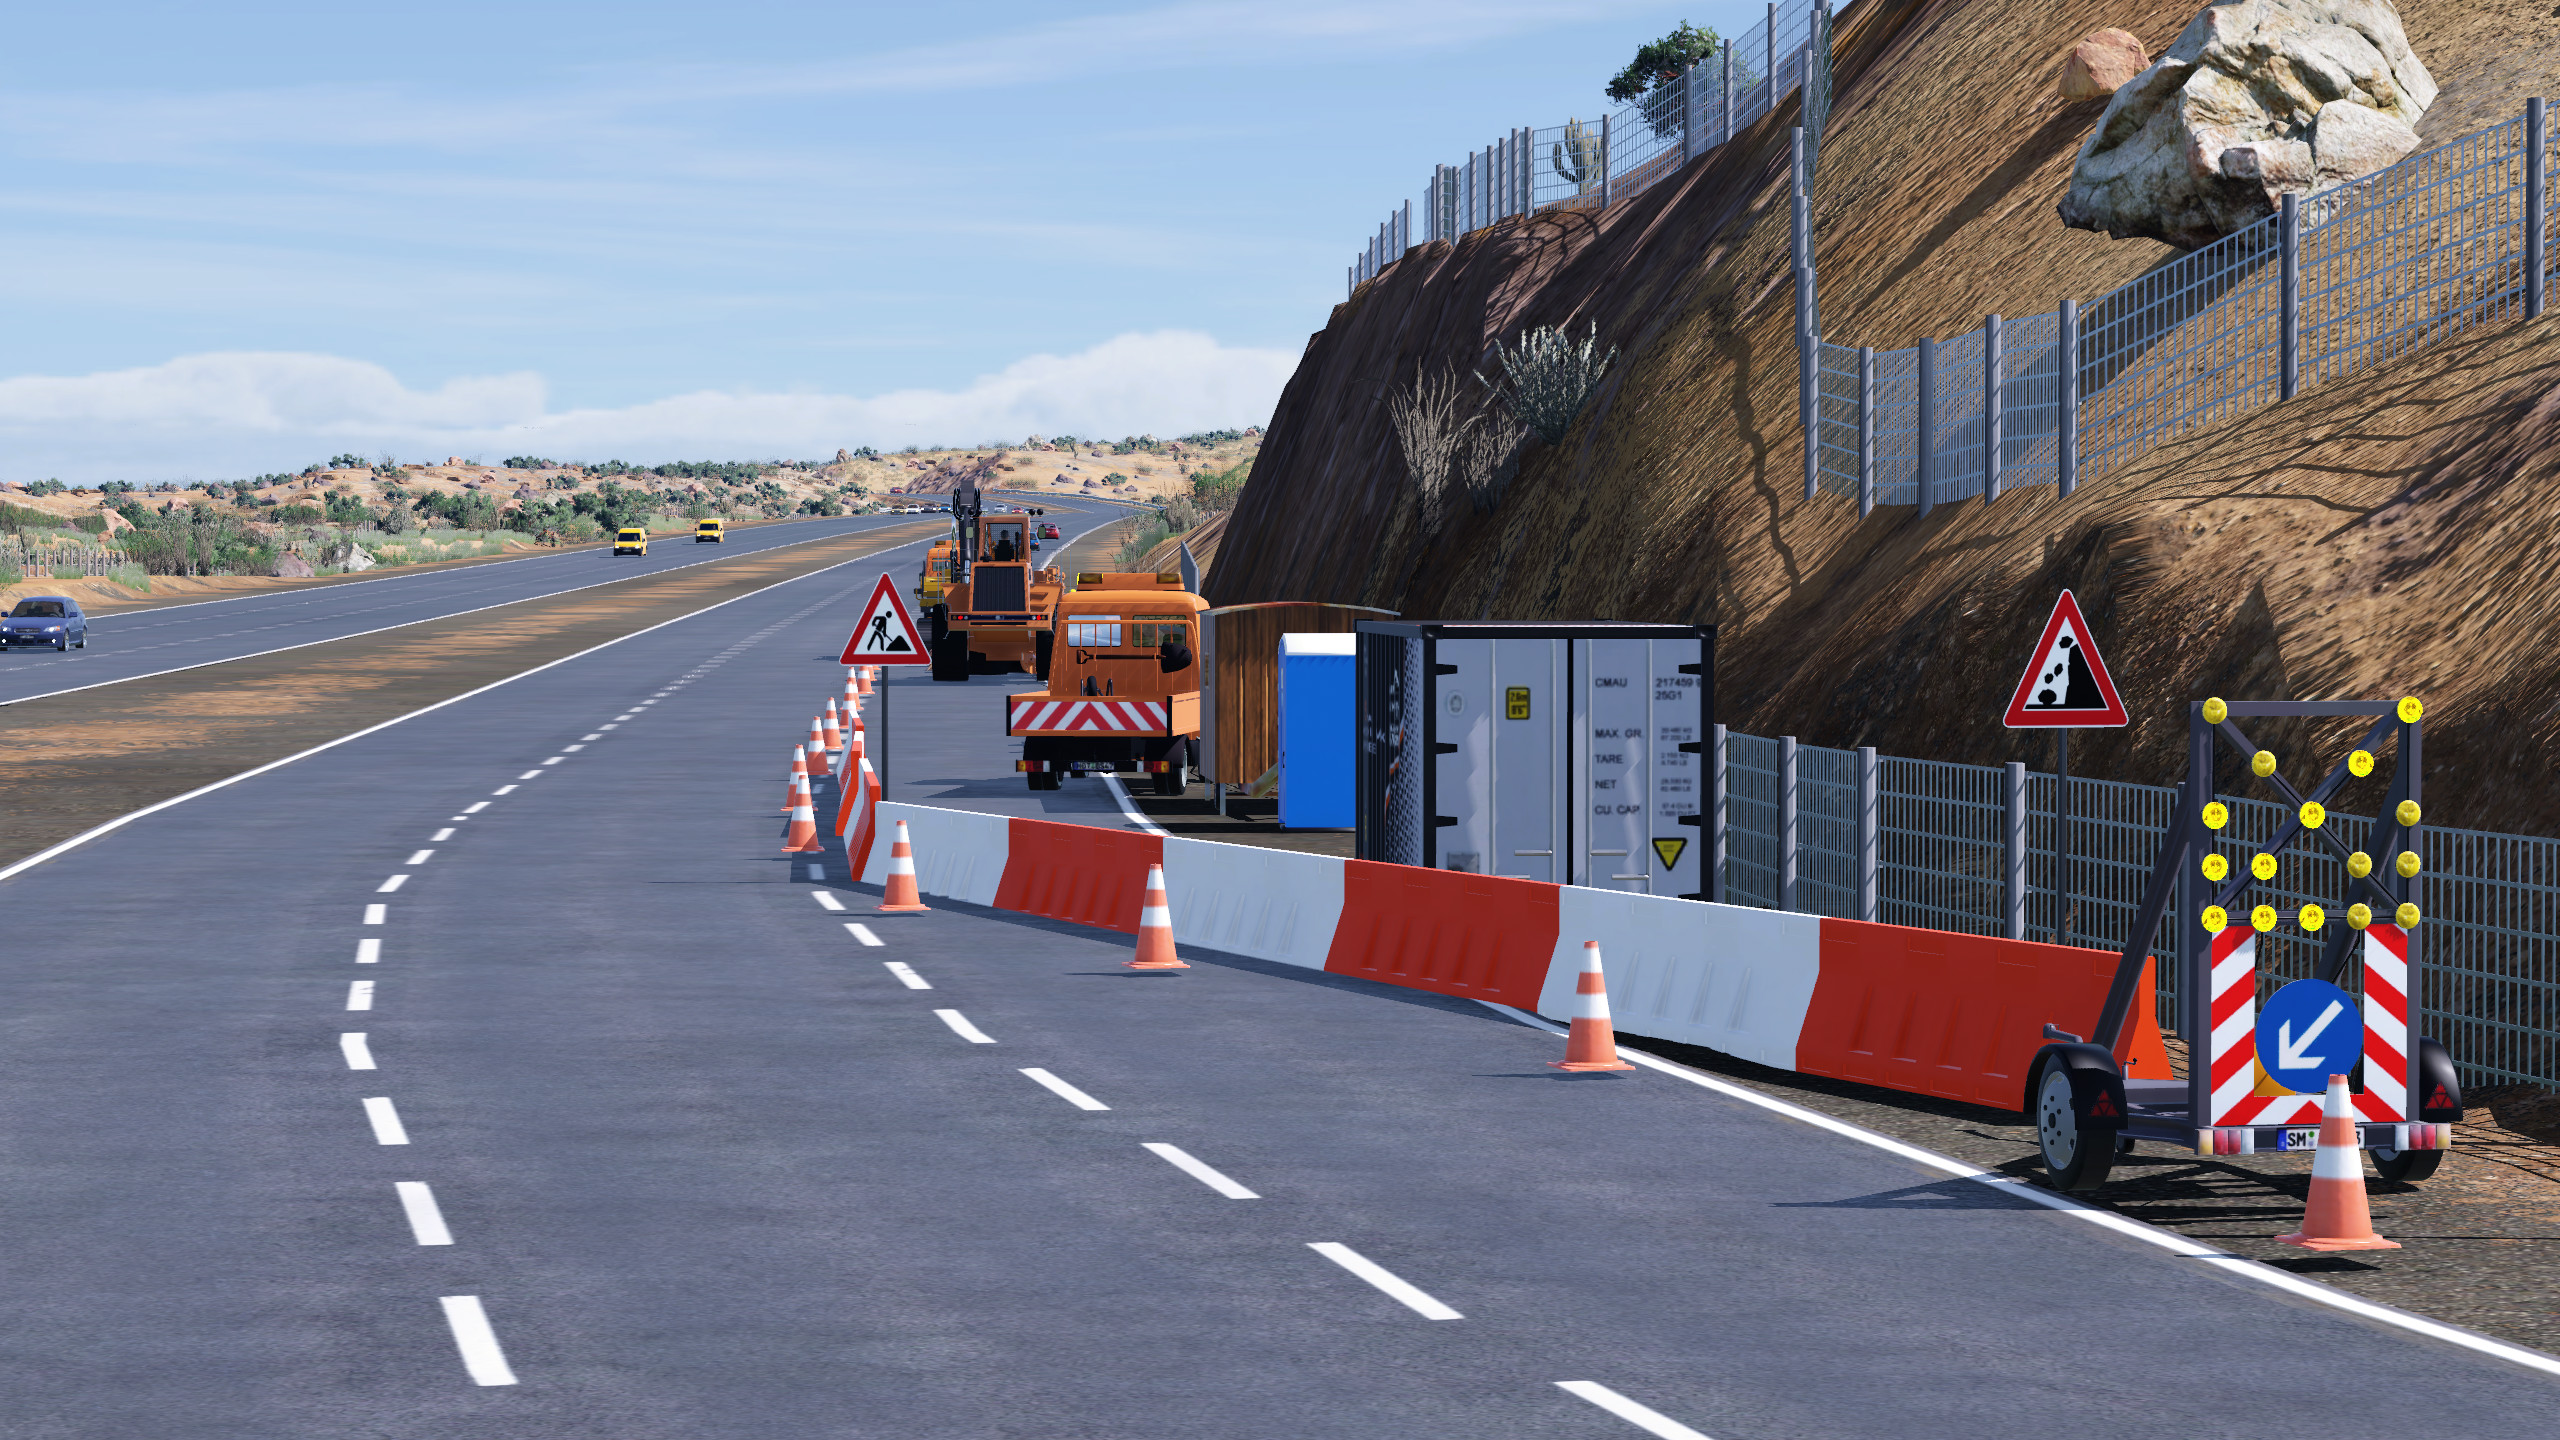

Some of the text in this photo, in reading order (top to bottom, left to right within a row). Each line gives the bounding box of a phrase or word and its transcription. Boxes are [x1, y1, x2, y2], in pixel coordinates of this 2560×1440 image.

[1594, 676, 1629, 689] CMAU
[1655, 676, 1694, 688] 217459
[1594, 754, 1624, 765] TARE
[1594, 778, 1617, 789] NET
[2287, 1132, 2307, 1147] SM
